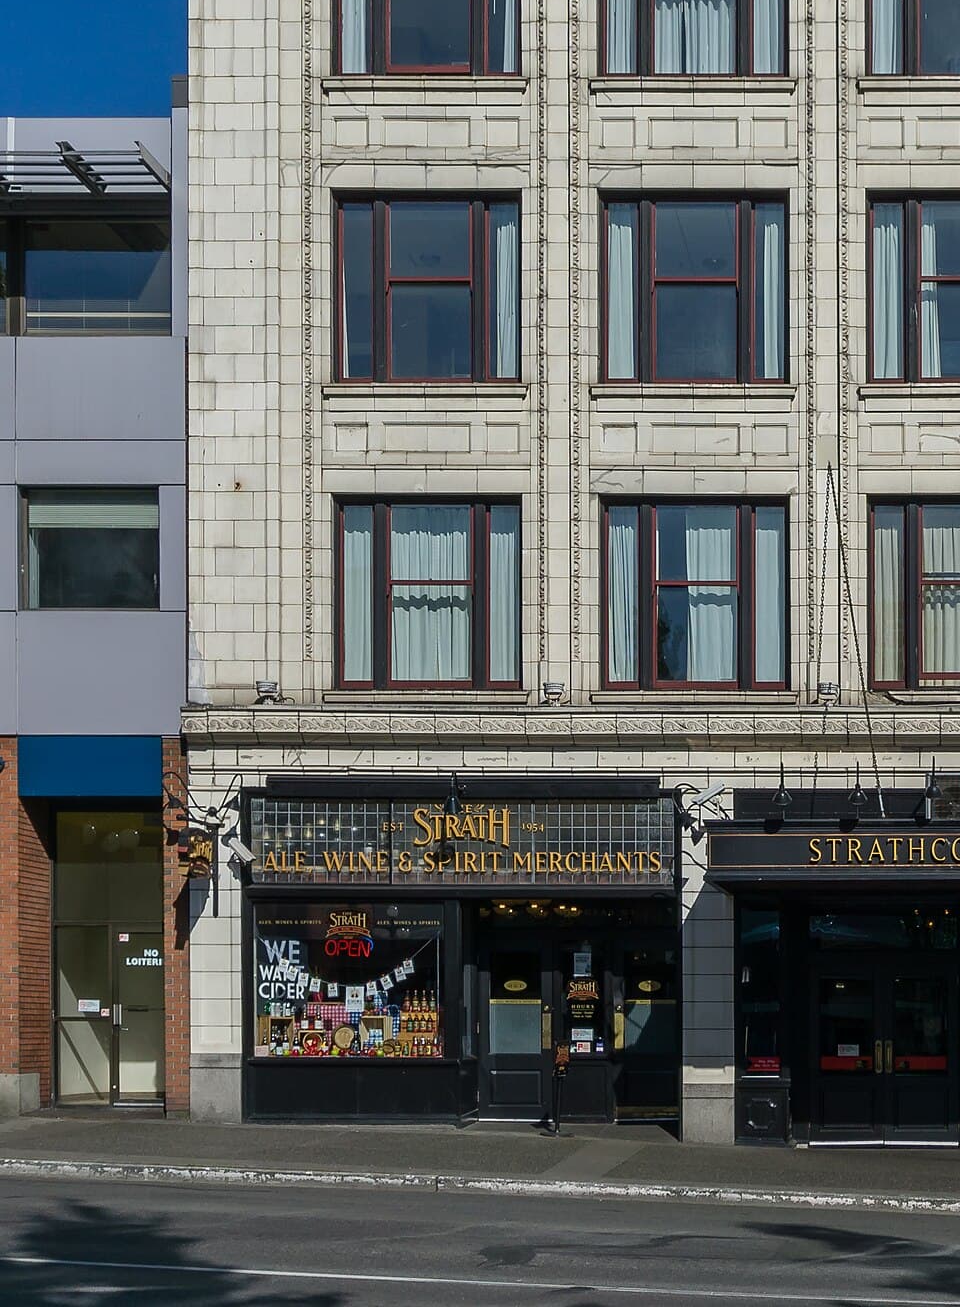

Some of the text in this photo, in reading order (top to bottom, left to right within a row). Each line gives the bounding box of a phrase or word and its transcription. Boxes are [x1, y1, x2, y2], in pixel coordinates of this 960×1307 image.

[382, 822, 404, 832] EST
[413, 807, 511, 849] STRATH
[521, 823, 544, 834] 1954
[264, 851, 313, 873] ALE,
[323, 851, 389, 872] WINE
[398, 851, 413, 873] &
[513, 851, 662, 873] MERCHANTS
[329, 912, 367, 928] STRATH
[143, 948, 159, 957] NO
[264, 939, 300, 964] WE
[324, 939, 370, 957] OPEN
[126, 957, 162, 966] LOITERI
[258, 982, 305, 1000] CIDER
